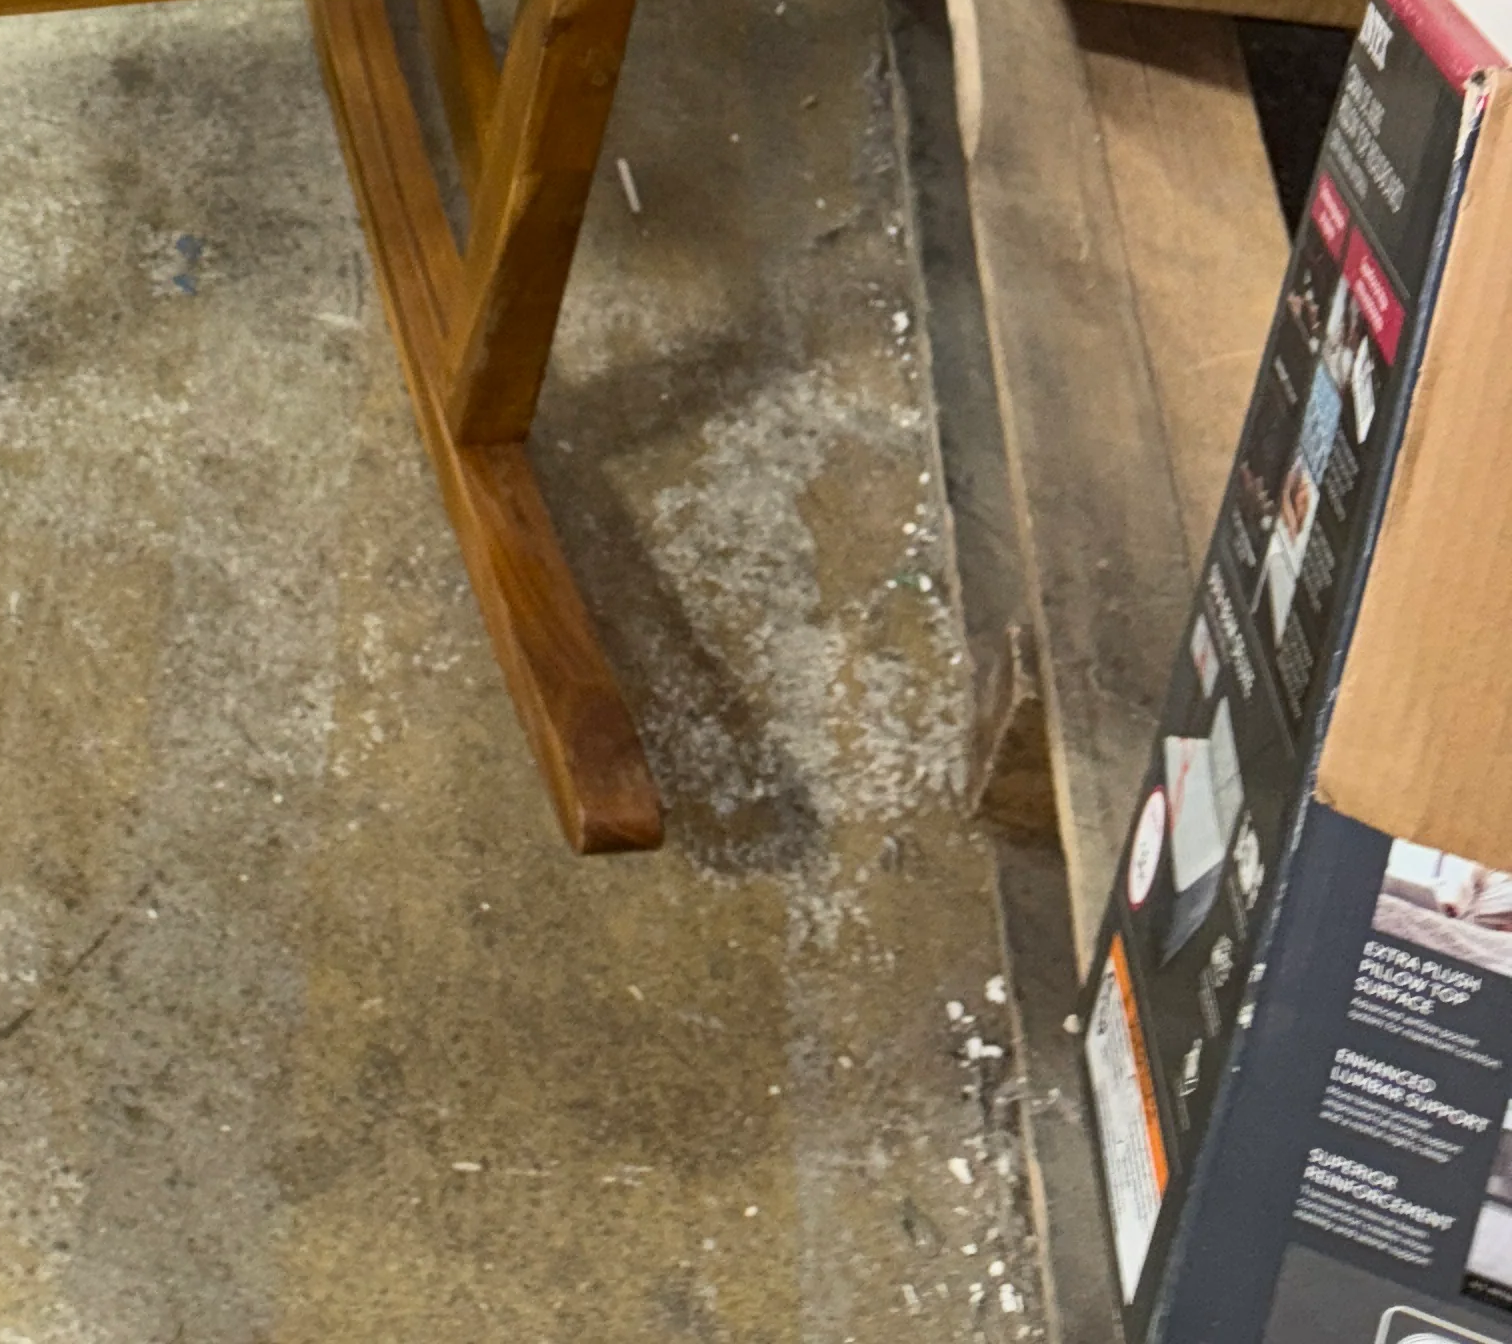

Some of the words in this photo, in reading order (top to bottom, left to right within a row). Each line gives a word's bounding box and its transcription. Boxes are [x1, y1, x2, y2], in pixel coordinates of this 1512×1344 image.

[1358, 958, 1430, 993] PILLOW
[1428, 982, 1471, 1006] TOP
[1362, 940, 1421, 973] EXTRA
[1420, 960, 1483, 993] PLUSH
[1353, 975, 1437, 1015] SURFACE
[1334, 1047, 1437, 1094] ENHANCED
[1329, 1065, 1406, 1104] LUMBAR
[1404, 1092, 1492, 1133] SUPPORT
[1307, 1147, 1399, 1191] SUPERIOR
[1303, 1165, 1457, 1231] REINFORCEMENT
